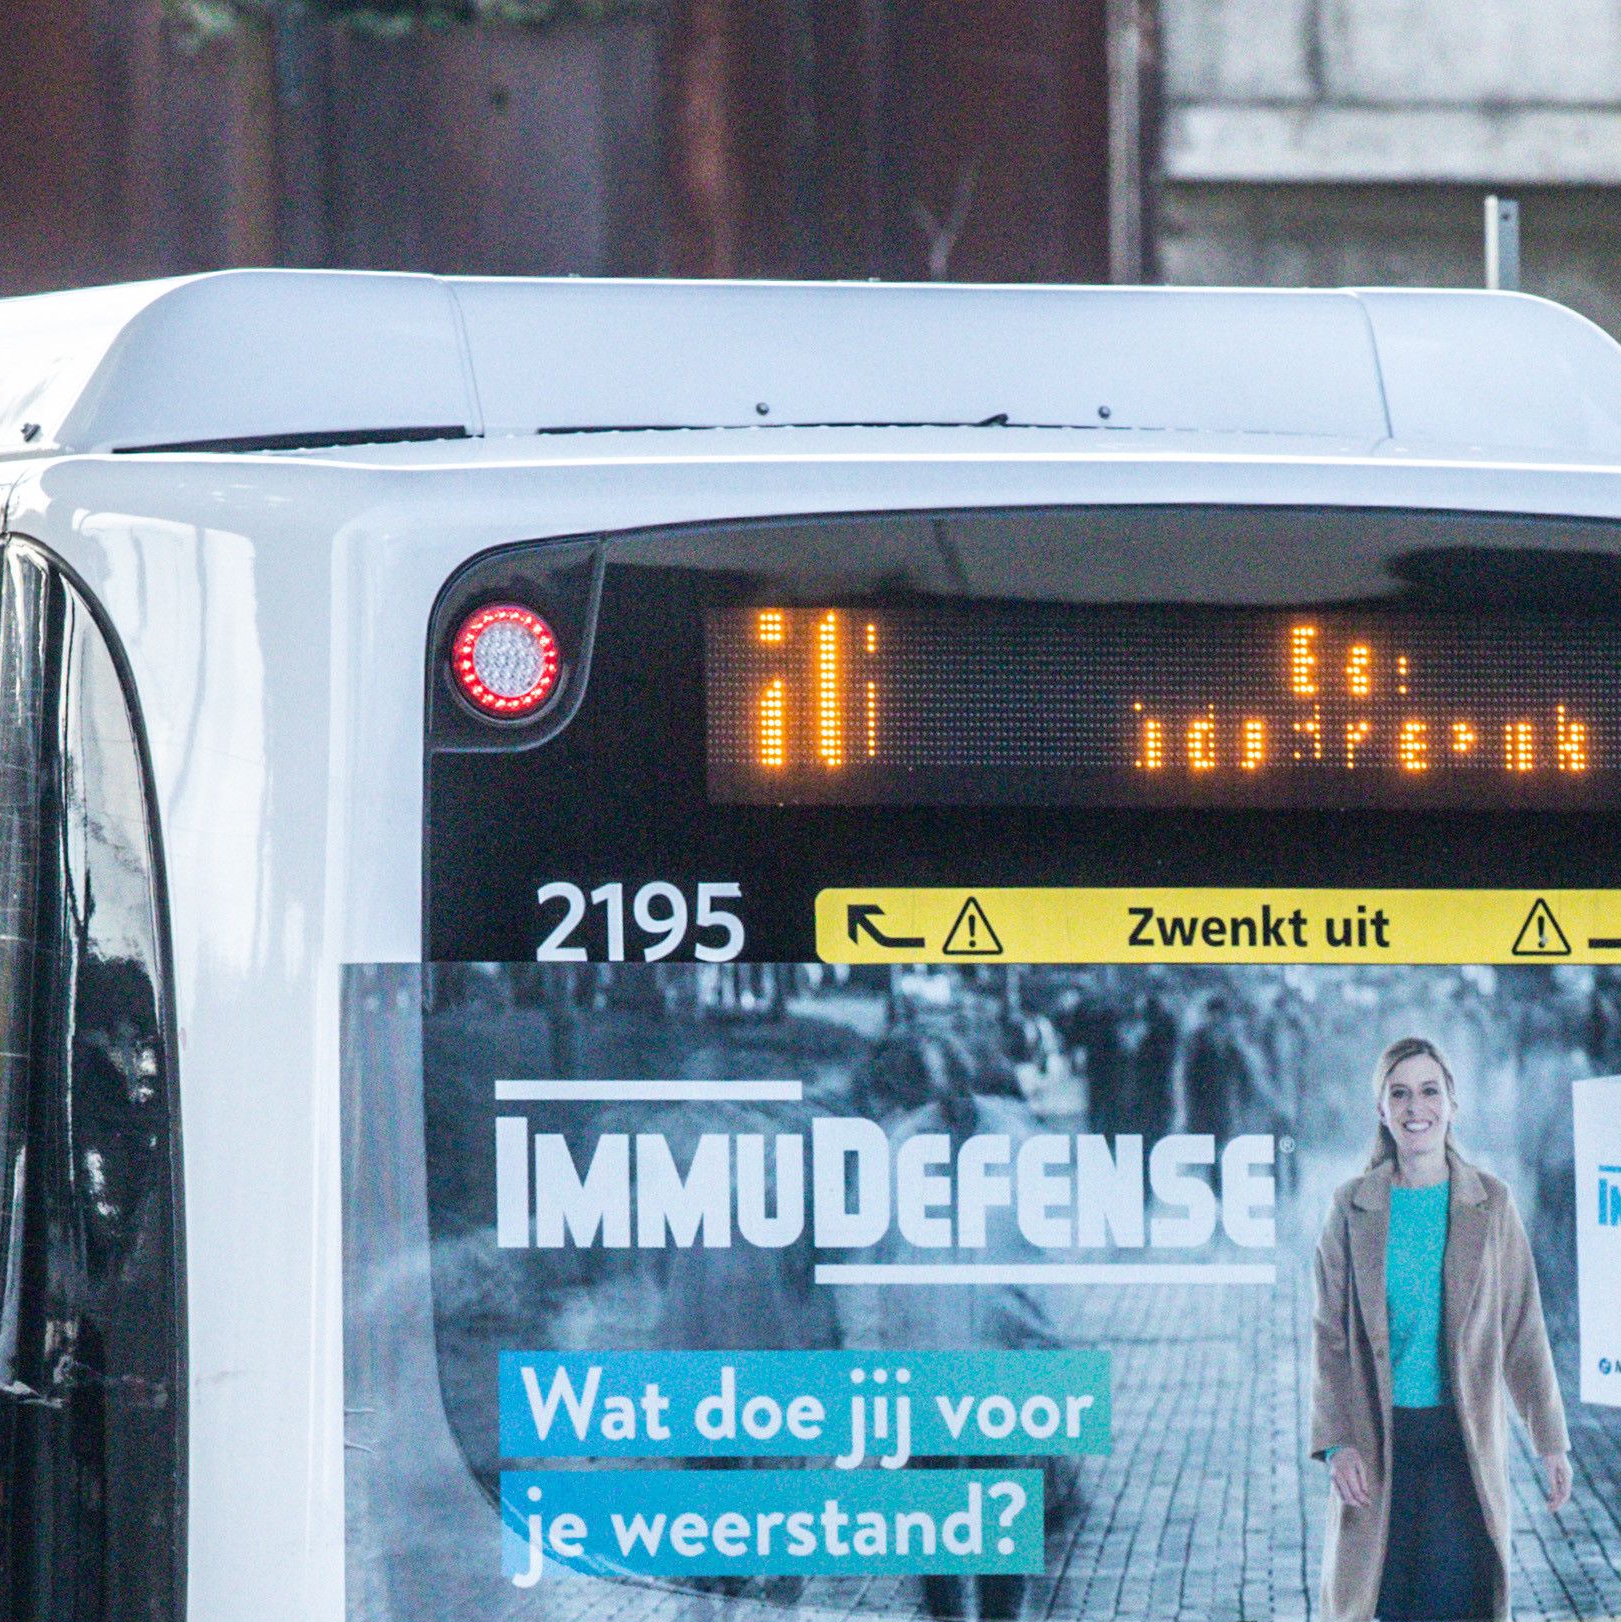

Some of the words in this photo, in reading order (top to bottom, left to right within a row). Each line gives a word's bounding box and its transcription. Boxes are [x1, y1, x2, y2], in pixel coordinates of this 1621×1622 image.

[536, 880, 745, 962] 2195
[1128, 904, 1308, 947] Zwenkt
[1326, 905, 1390, 948] uit
[520, 1366, 670, 1442] Wat
[694, 1366, 825, 1441] doe
[835, 1368, 911, 1470] jij
[935, 1391, 1094, 1440] voor
[512, 1487, 588, 1589] je
[610, 1481, 1027, 1557] weerstand?
